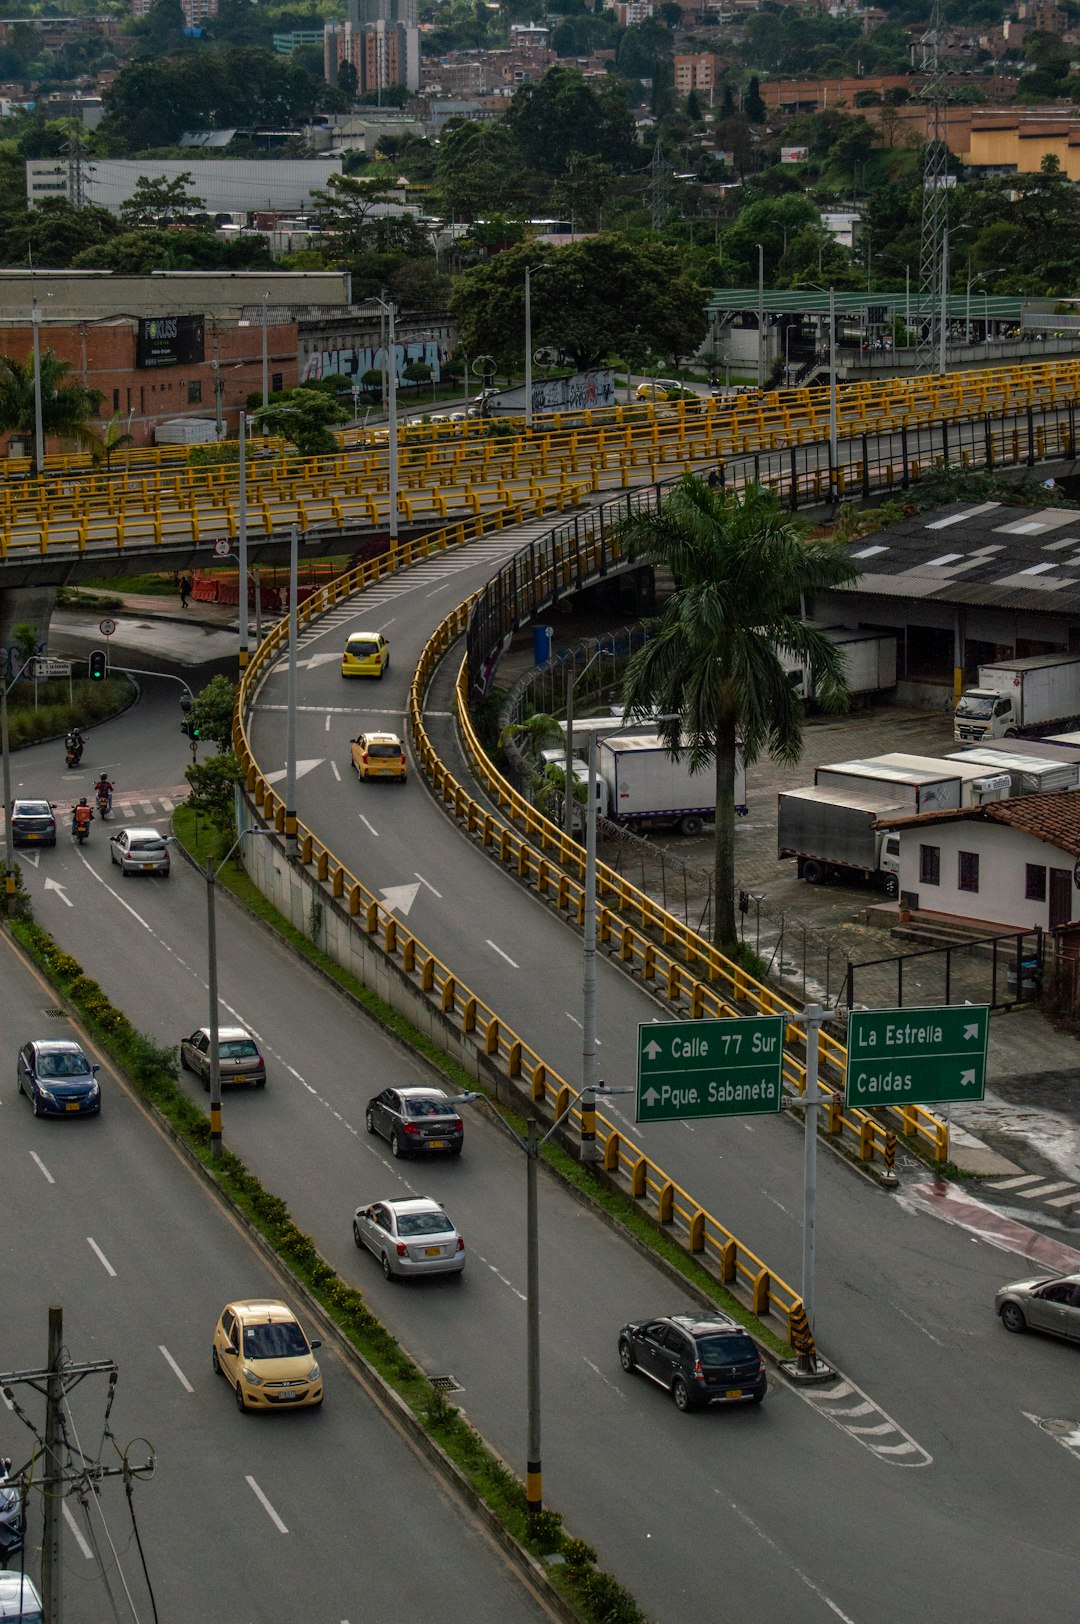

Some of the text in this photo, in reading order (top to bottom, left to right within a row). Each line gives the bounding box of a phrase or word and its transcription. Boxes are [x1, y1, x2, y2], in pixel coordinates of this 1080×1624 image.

[671, 1032, 777, 1058] Calle 77 Sur
[858, 1023, 943, 1047] La Estrella
[660, 1078, 775, 1109] Pque. Sabaneta
[857, 1071, 912, 1093] Caldas
